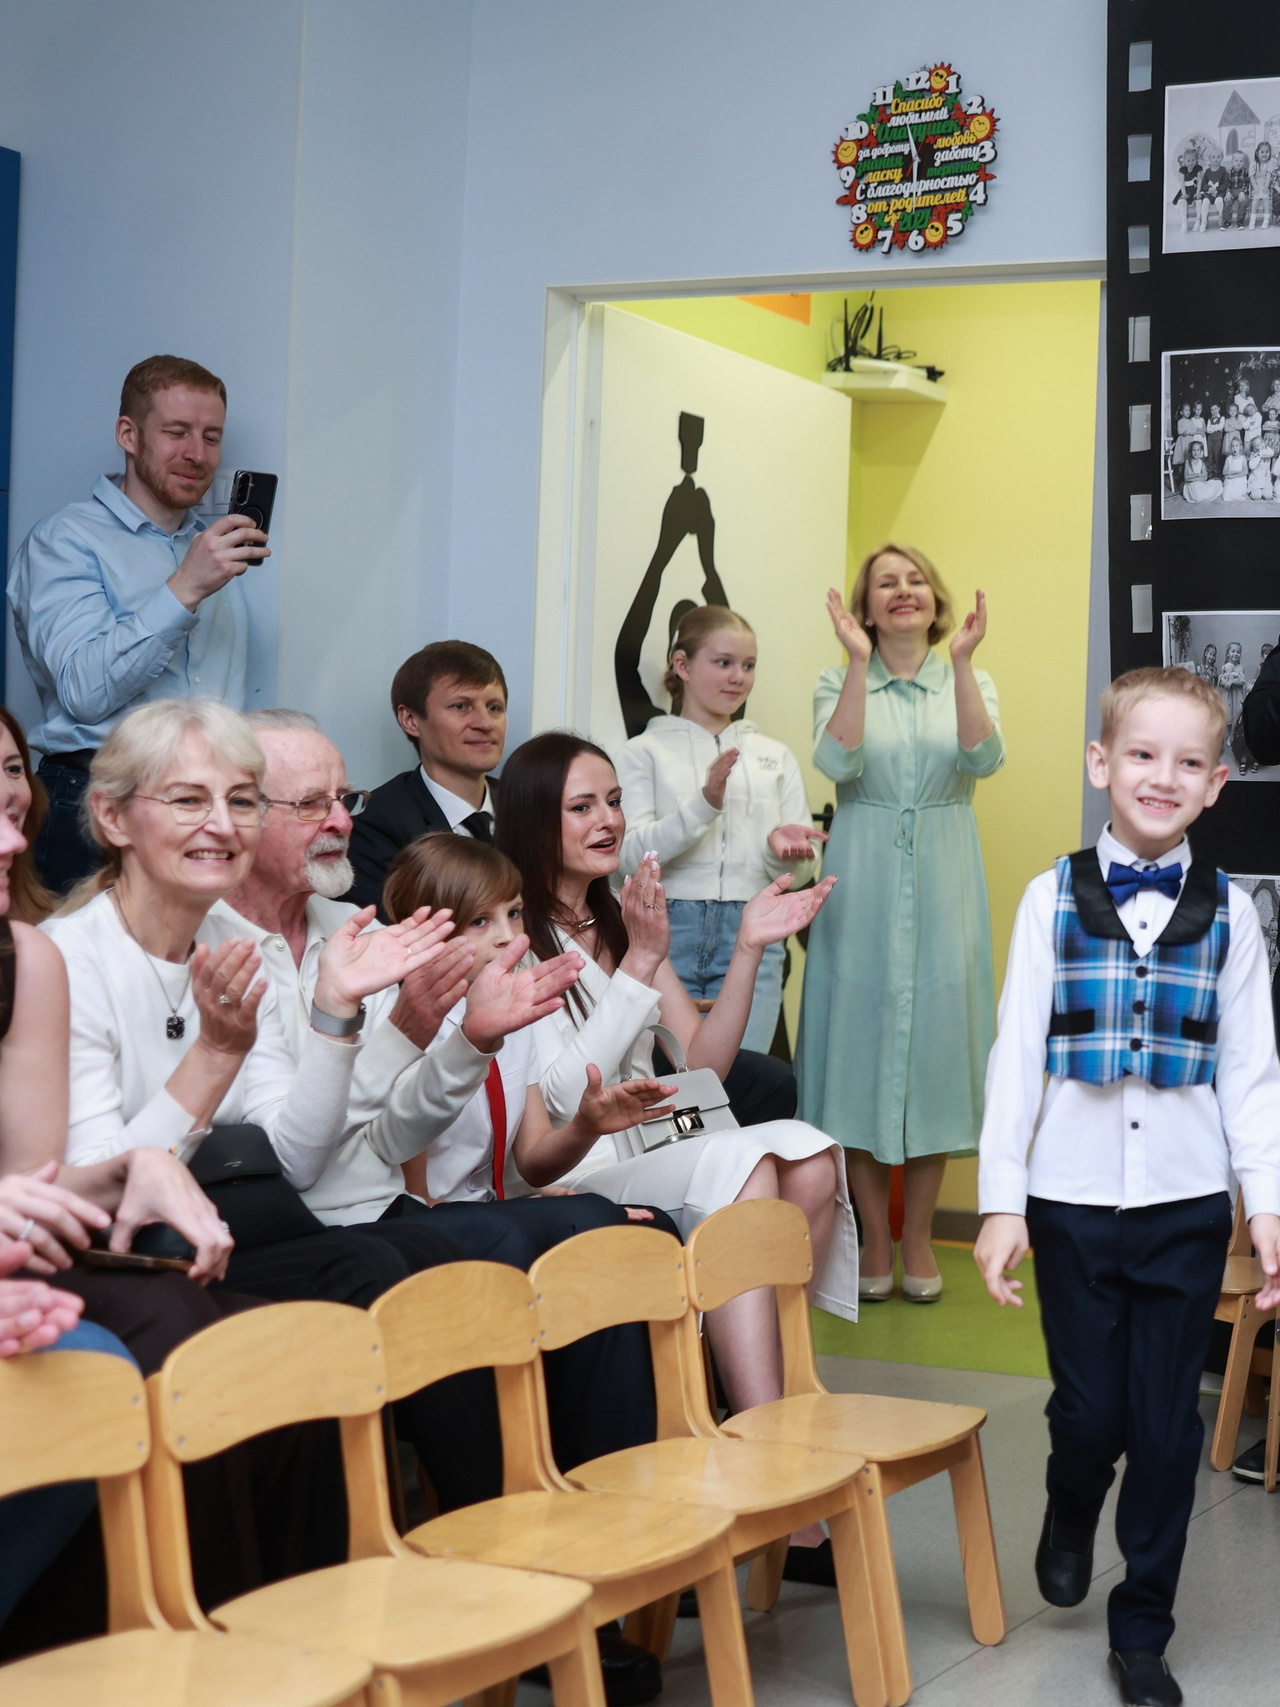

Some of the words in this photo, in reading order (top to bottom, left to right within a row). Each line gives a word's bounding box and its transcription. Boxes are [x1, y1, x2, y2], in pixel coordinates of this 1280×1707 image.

[905, 71, 930, 91] 12
[945, 74, 960, 94] 1
[872, 86, 895, 105] 11
[891, 92, 946, 114] Спасибо
[966, 96, 983, 115] 2
[845, 121, 869, 140] 10
[933, 130, 978, 149] любовь
[858, 149, 871, 161] за
[870, 143, 911, 161] доброту
[934, 146, 980, 167] заботу
[978, 141, 995, 163] 3
[856, 155, 904, 177] знания
[864, 168, 904, 184] ласку
[927, 161, 981, 179] терпение
[840, 166, 856, 188] 9
[856, 185, 867, 201] С
[867, 200, 889, 214] от
[889, 188, 968, 216] родителей
[969, 182, 986, 205] 4
[851, 204, 868, 225] 8
[947, 213, 963, 236] 5
[877, 230, 893, 252] 7
[907, 230, 924, 251] 6
